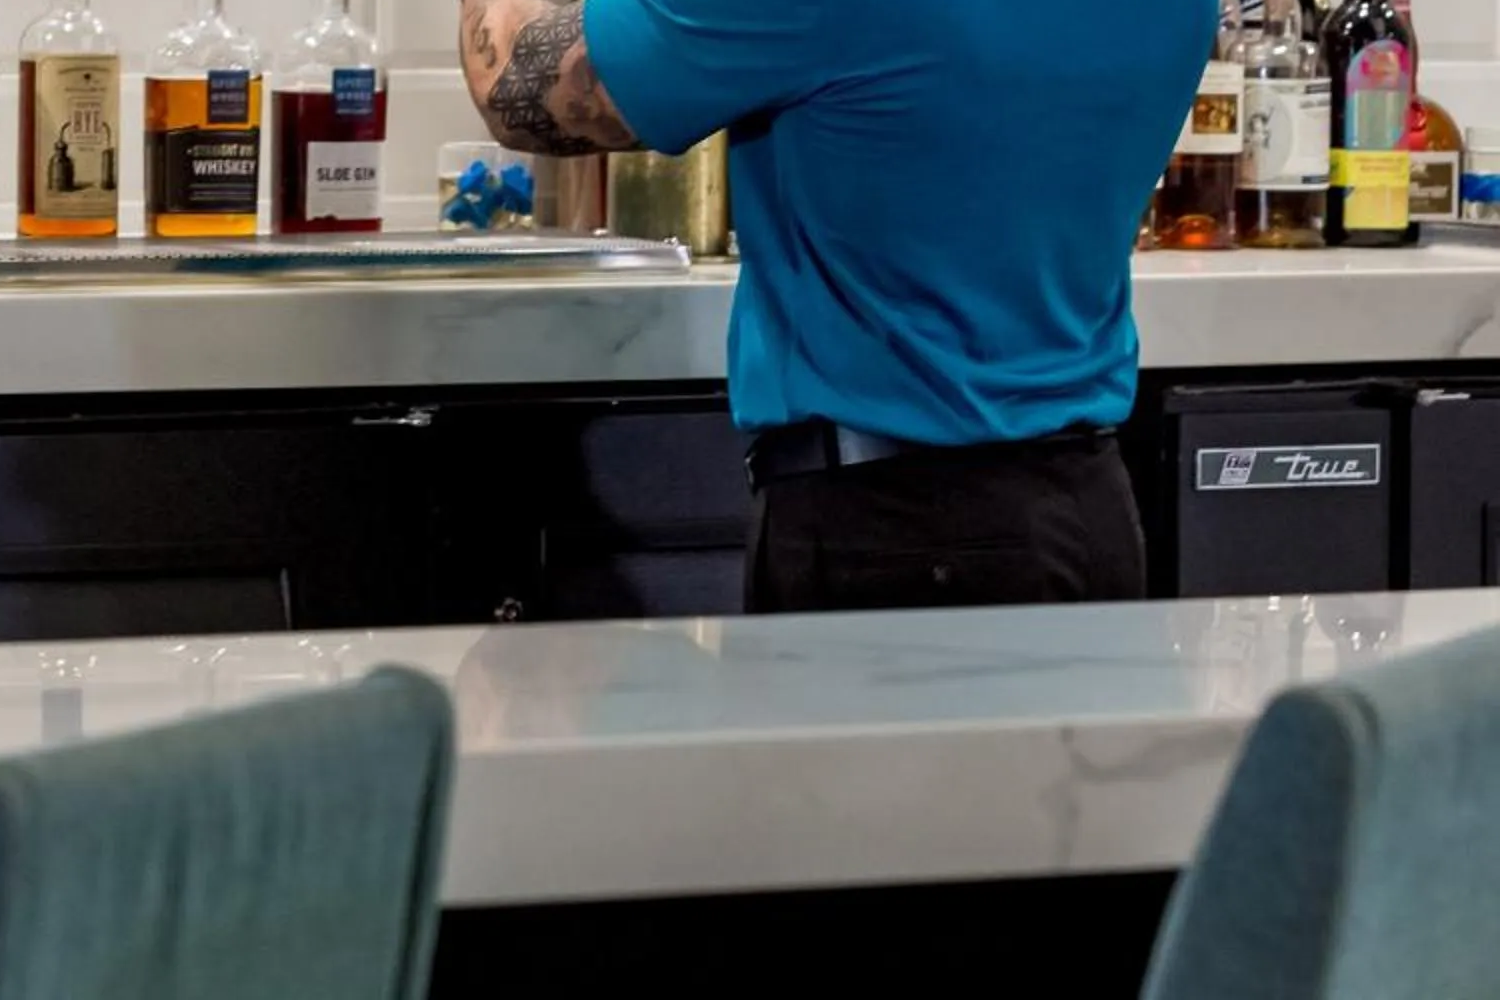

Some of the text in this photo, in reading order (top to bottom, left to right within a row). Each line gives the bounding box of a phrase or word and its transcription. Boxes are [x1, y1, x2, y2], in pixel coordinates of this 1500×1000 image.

[192, 159, 256, 176] WHISKEY
[316, 167, 377, 181] SLOE GIN
